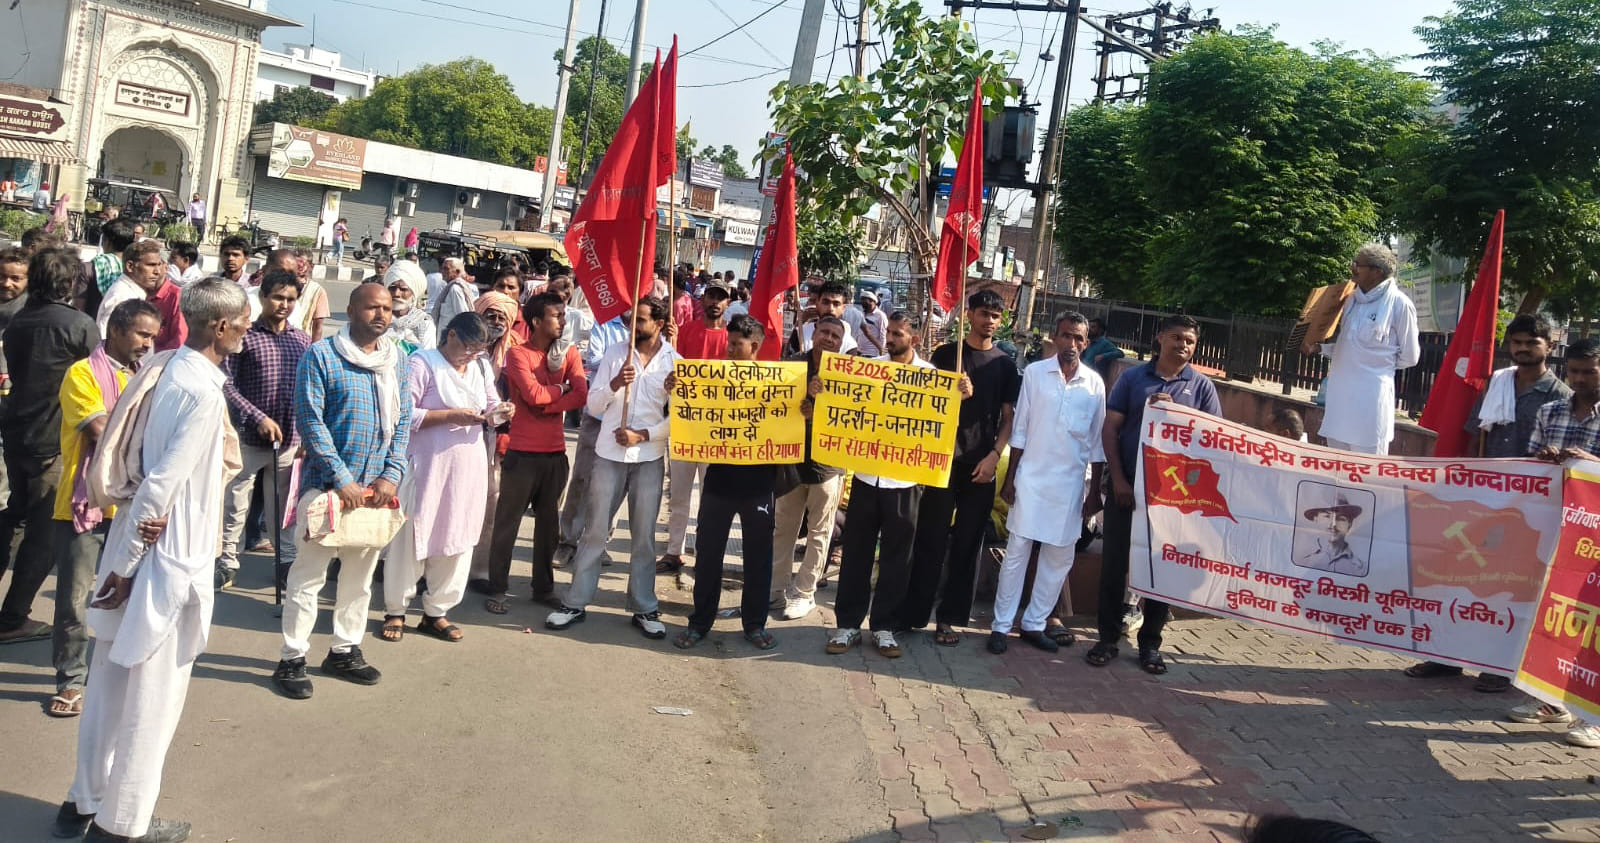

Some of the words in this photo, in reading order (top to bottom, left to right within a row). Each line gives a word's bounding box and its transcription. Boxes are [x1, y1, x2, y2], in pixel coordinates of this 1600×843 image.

[590, 273, 618, 308] (1966)
[676, 363, 726, 380] BOCW
[826, 357, 832, 372] 1
[833, 355, 855, 375] मई
[675, 379, 698, 400] बोर्ड
[701, 384, 721, 400] का
[722, 380, 758, 401] पोर्टल
[880, 382, 928, 409] दिवस
[928, 394, 950, 415] पर
[675, 401, 704, 421] खोल
[704, 407, 725, 424] कर
[768, 401, 792, 418] को
[709, 425, 742, 440] लाभ
[673, 442, 695, 459] जन
[728, 442, 756, 460] मंच
[756, 438, 803, 461] हरियाणा
[819, 433, 844, 452] जन
[880, 441, 908, 464] मंच
[905, 443, 952, 471] हरियाणा
[1148, 420, 1154, 438] 1
[1160, 419, 1195, 447] मई
[1198, 427, 1296, 466] अंतर्राष्ट्रीय
[1300, 455, 1373, 483] मजदूर
[1377, 462, 1438, 484] दिवस
[1444, 464, 1552, 497] जिन्दाबाद
[1161, 543, 1251, 581] निर्माणकार्य
[1254, 569, 1314, 599] मजदूर
[1317, 577, 1370, 603] मिस्त्री
[1375, 589, 1443, 616] यूनियन
[1449, 598, 1516, 634] (रजि.)
[1225, 589, 1278, 610] दुनिया
[1281, 600, 1301, 617] के
[1305, 607, 1372, 635] मजदूरों
[1373, 620, 1407, 637] एक
[1411, 623, 1433, 642] हो
[1544, 592, 1600, 655] जन
[1557, 656, 1600, 689] मनरेगा
